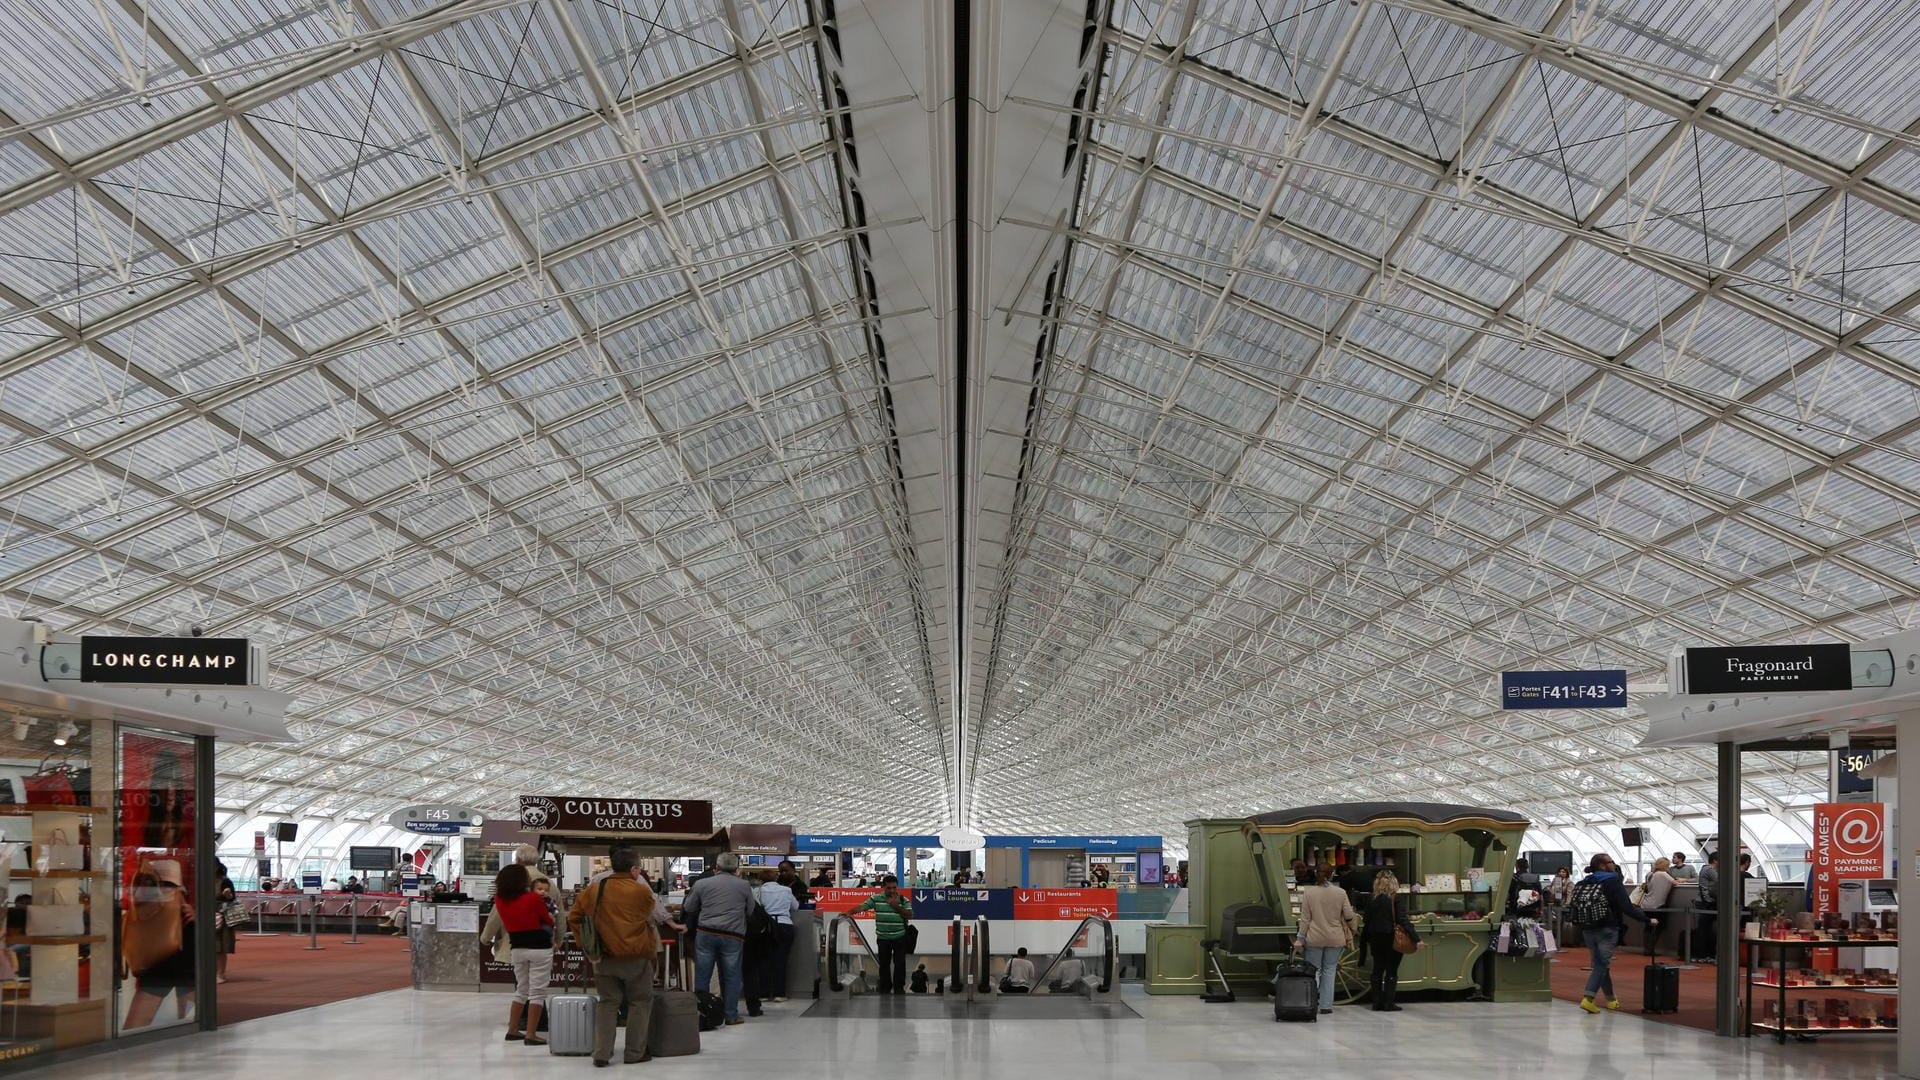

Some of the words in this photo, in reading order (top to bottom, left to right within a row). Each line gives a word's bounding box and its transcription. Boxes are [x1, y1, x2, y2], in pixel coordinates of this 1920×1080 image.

[92, 653, 236, 668] LONGCHAMP
[1726, 656, 1813, 676] Fragonard
[1543, 686, 1569, 699] F41
[1579, 685, 1607, 698] F43
[426, 809, 450, 820] F45
[564, 800, 683, 817] COLUMBUS
[595, 817, 653, 830] CAFÉ&CO
[1818, 872, 1829, 882] &
